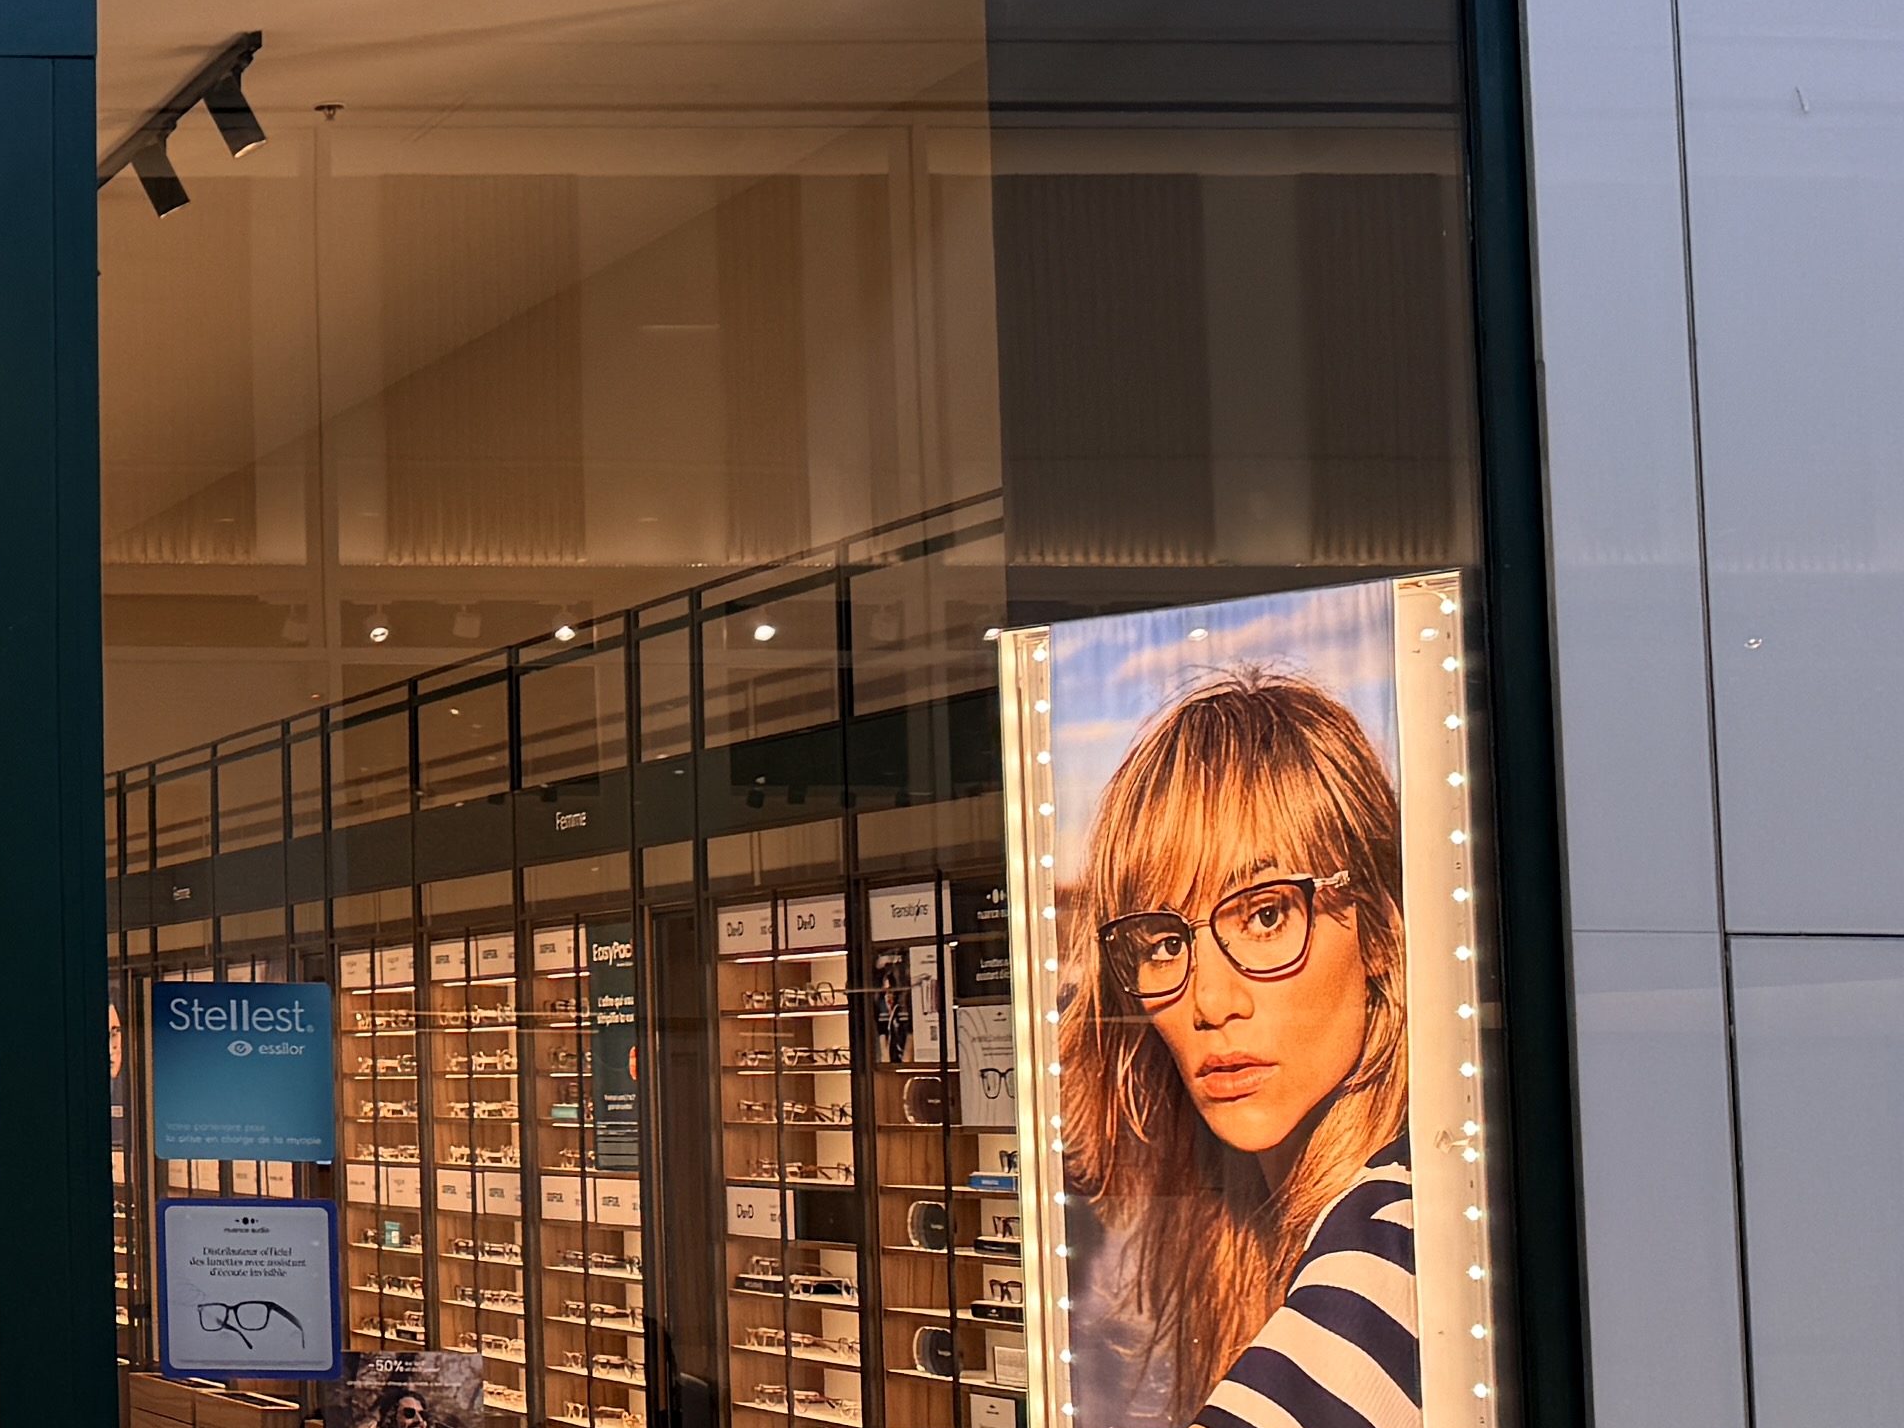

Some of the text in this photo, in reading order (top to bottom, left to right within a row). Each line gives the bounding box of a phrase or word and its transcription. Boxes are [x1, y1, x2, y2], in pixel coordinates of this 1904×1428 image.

[556, 812, 586, 830] Femme
[592, 940, 633, 965] EasyPac
[258, 1042, 305, 1055] essilor
[286, 1137, 322, 1145] myopie
[368, 1359, 404, 1372] -50%
